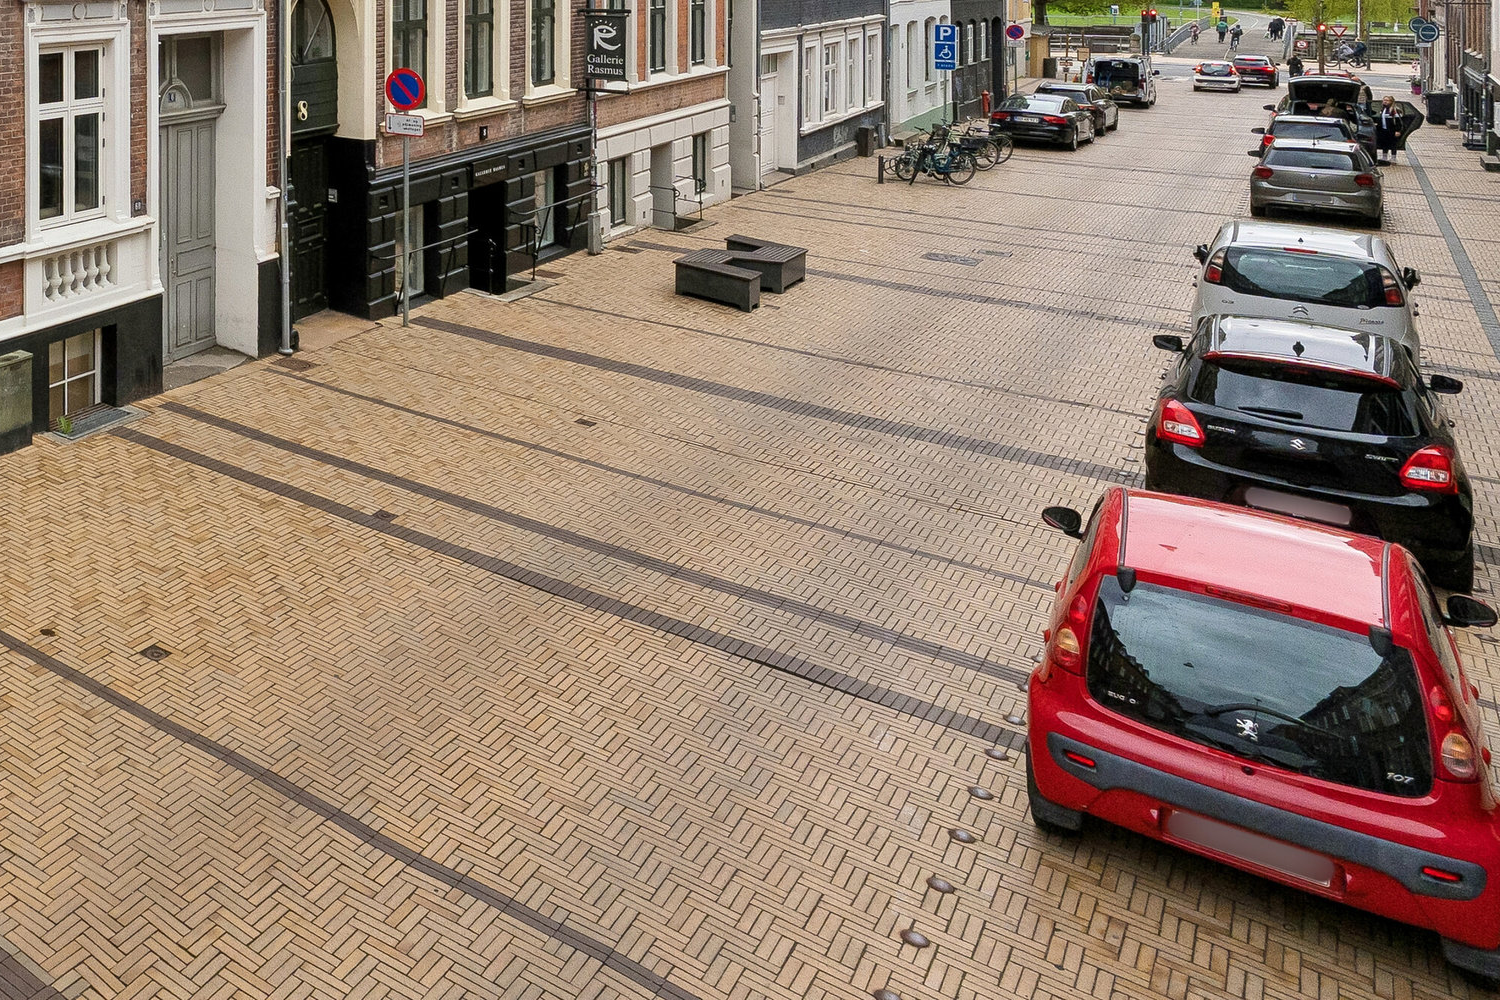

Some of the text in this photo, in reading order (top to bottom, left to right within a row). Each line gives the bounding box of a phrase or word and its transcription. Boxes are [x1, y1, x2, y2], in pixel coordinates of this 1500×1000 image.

[940, 27, 951, 40] P
[587, 54, 623, 64] Gallerie
[587, 64, 624, 75] Rasmus
[298, 101, 308, 121] 8
[1387, 772, 1415, 784] 107
